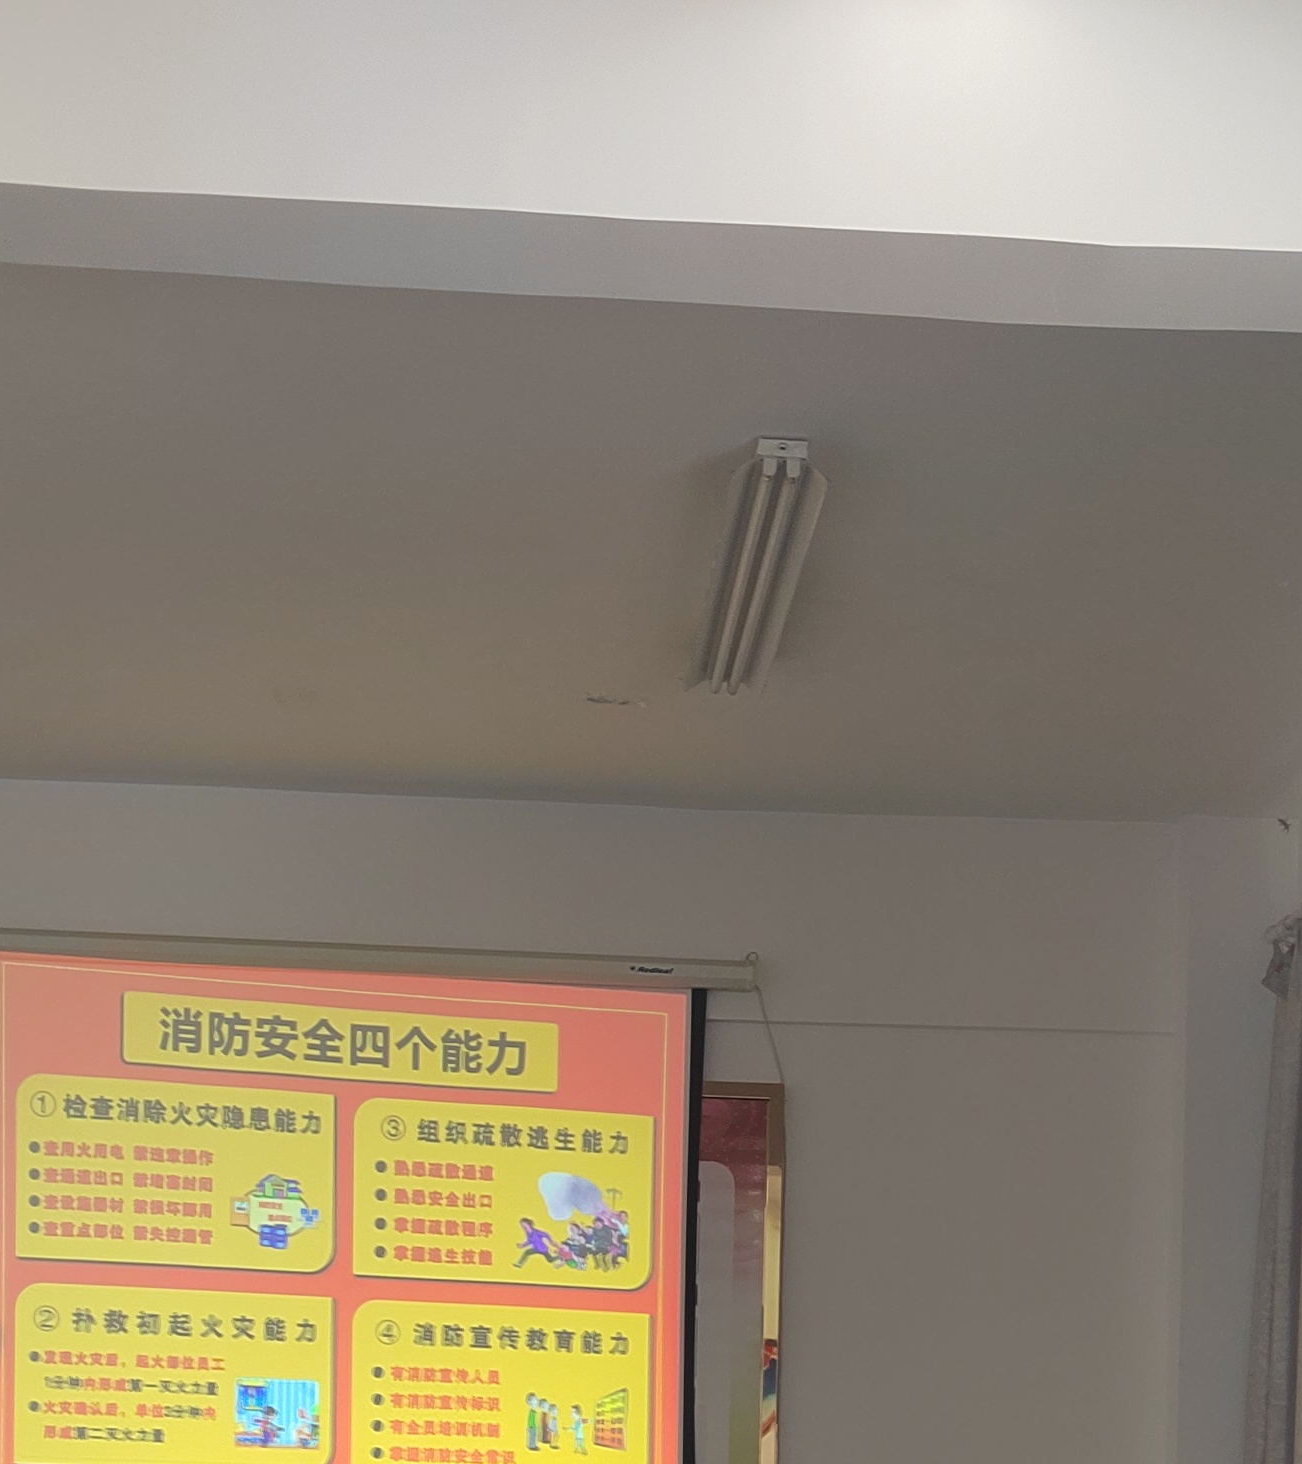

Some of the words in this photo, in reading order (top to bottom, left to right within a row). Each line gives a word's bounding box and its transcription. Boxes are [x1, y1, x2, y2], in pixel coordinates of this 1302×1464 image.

[157, 1005, 528, 1077] 消防安全四个能力
[62, 1093, 322, 1135] 检查消除火灾隐患能力
[416, 1118, 629, 1155] 组织疏散逃生能力
[71, 1307, 318, 1343] 扑救初起火灾能力
[412, 1321, 630, 1356] 消防宣传教育能力
